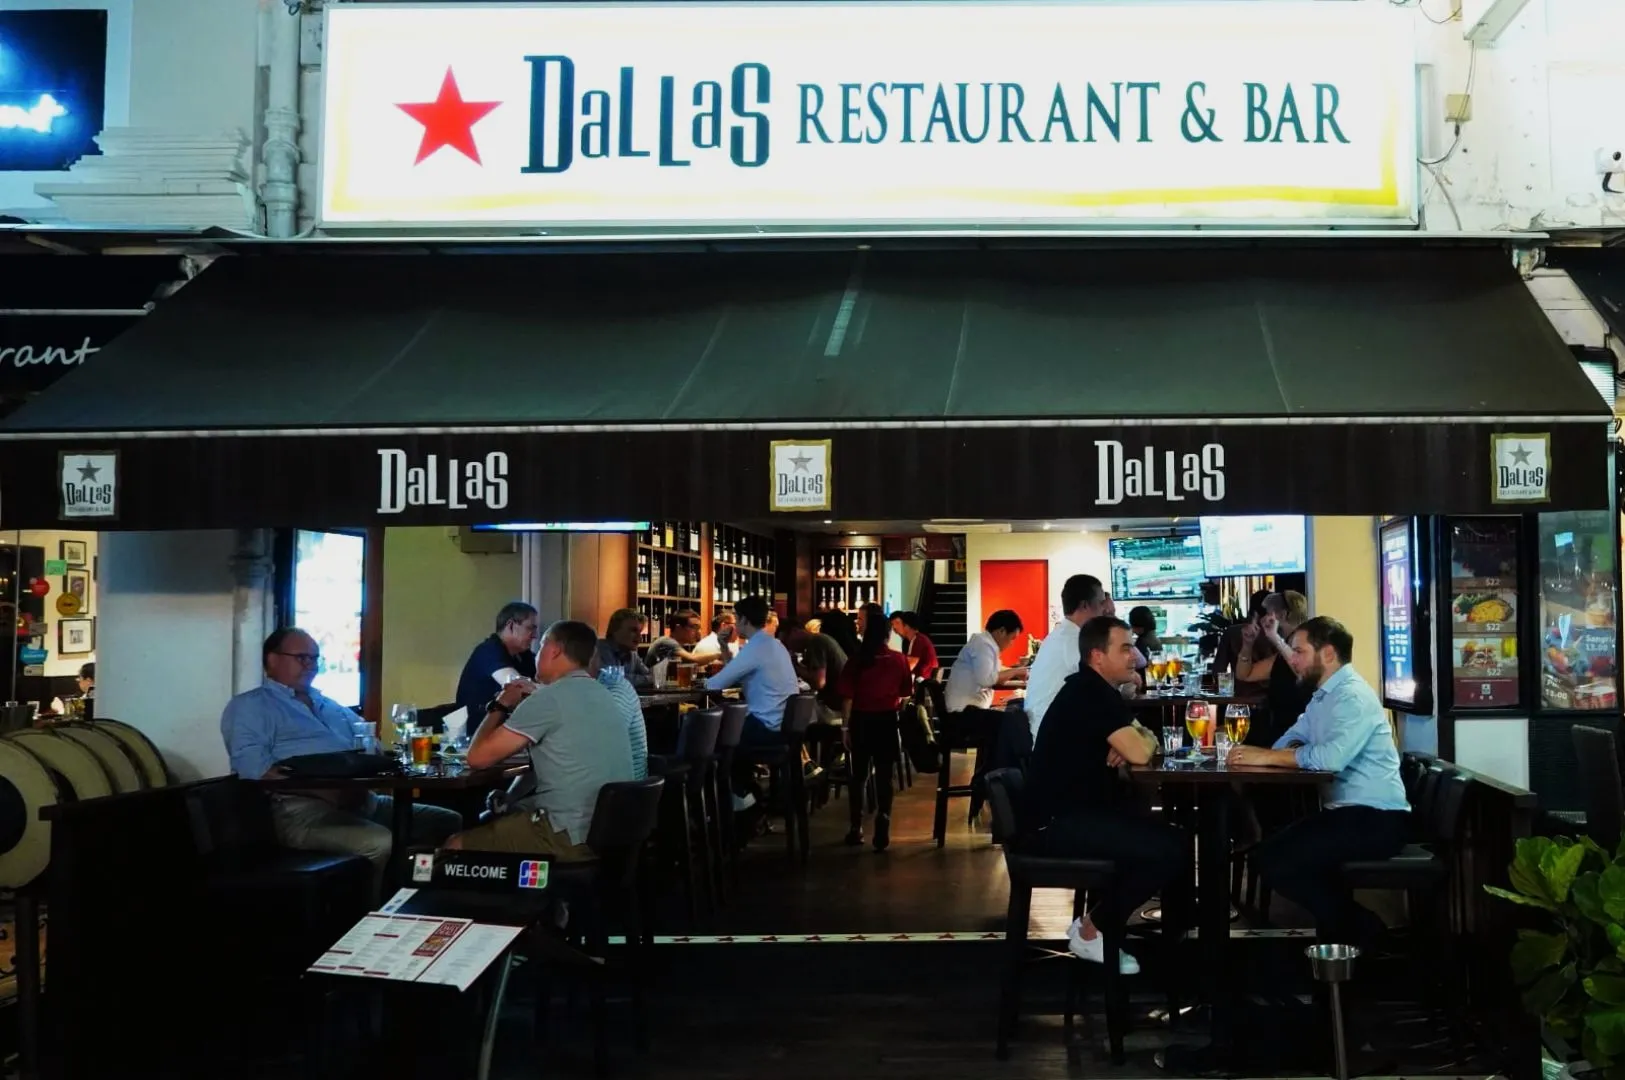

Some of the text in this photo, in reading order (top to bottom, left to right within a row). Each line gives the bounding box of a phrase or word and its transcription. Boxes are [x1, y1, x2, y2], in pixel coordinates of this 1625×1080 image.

[796, 81, 1160, 143] RESTAURANT
[1181, 81, 1223, 143] &
[1243, 82, 1351, 144] BAR
[445, 863, 508, 880] WELCOME
